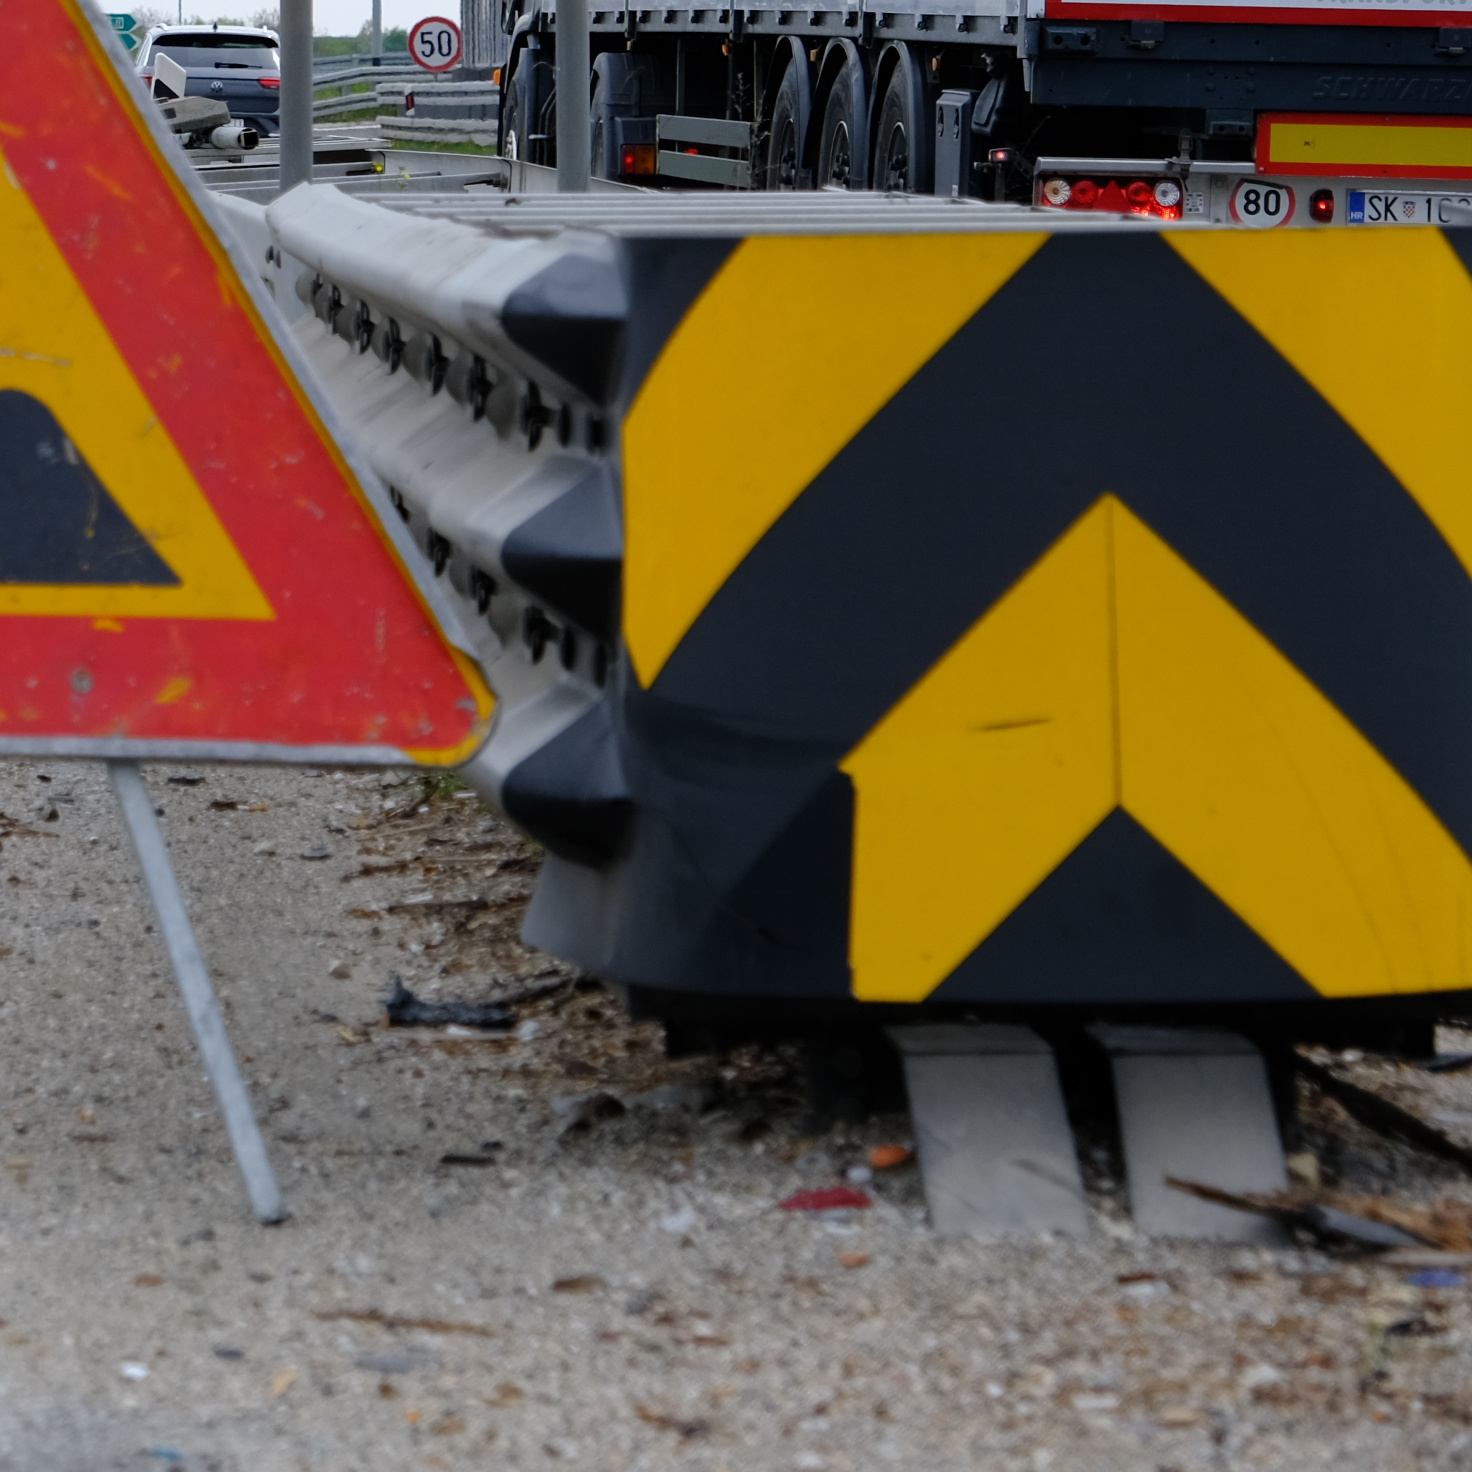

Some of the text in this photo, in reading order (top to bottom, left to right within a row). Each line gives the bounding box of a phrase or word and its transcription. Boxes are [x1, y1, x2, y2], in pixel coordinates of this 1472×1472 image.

[420, 30, 452, 58] 50
[1243, 188, 1281, 216] 80
[1350, 211, 1363, 220] HR
[1368, 195, 1398, 222] SK
